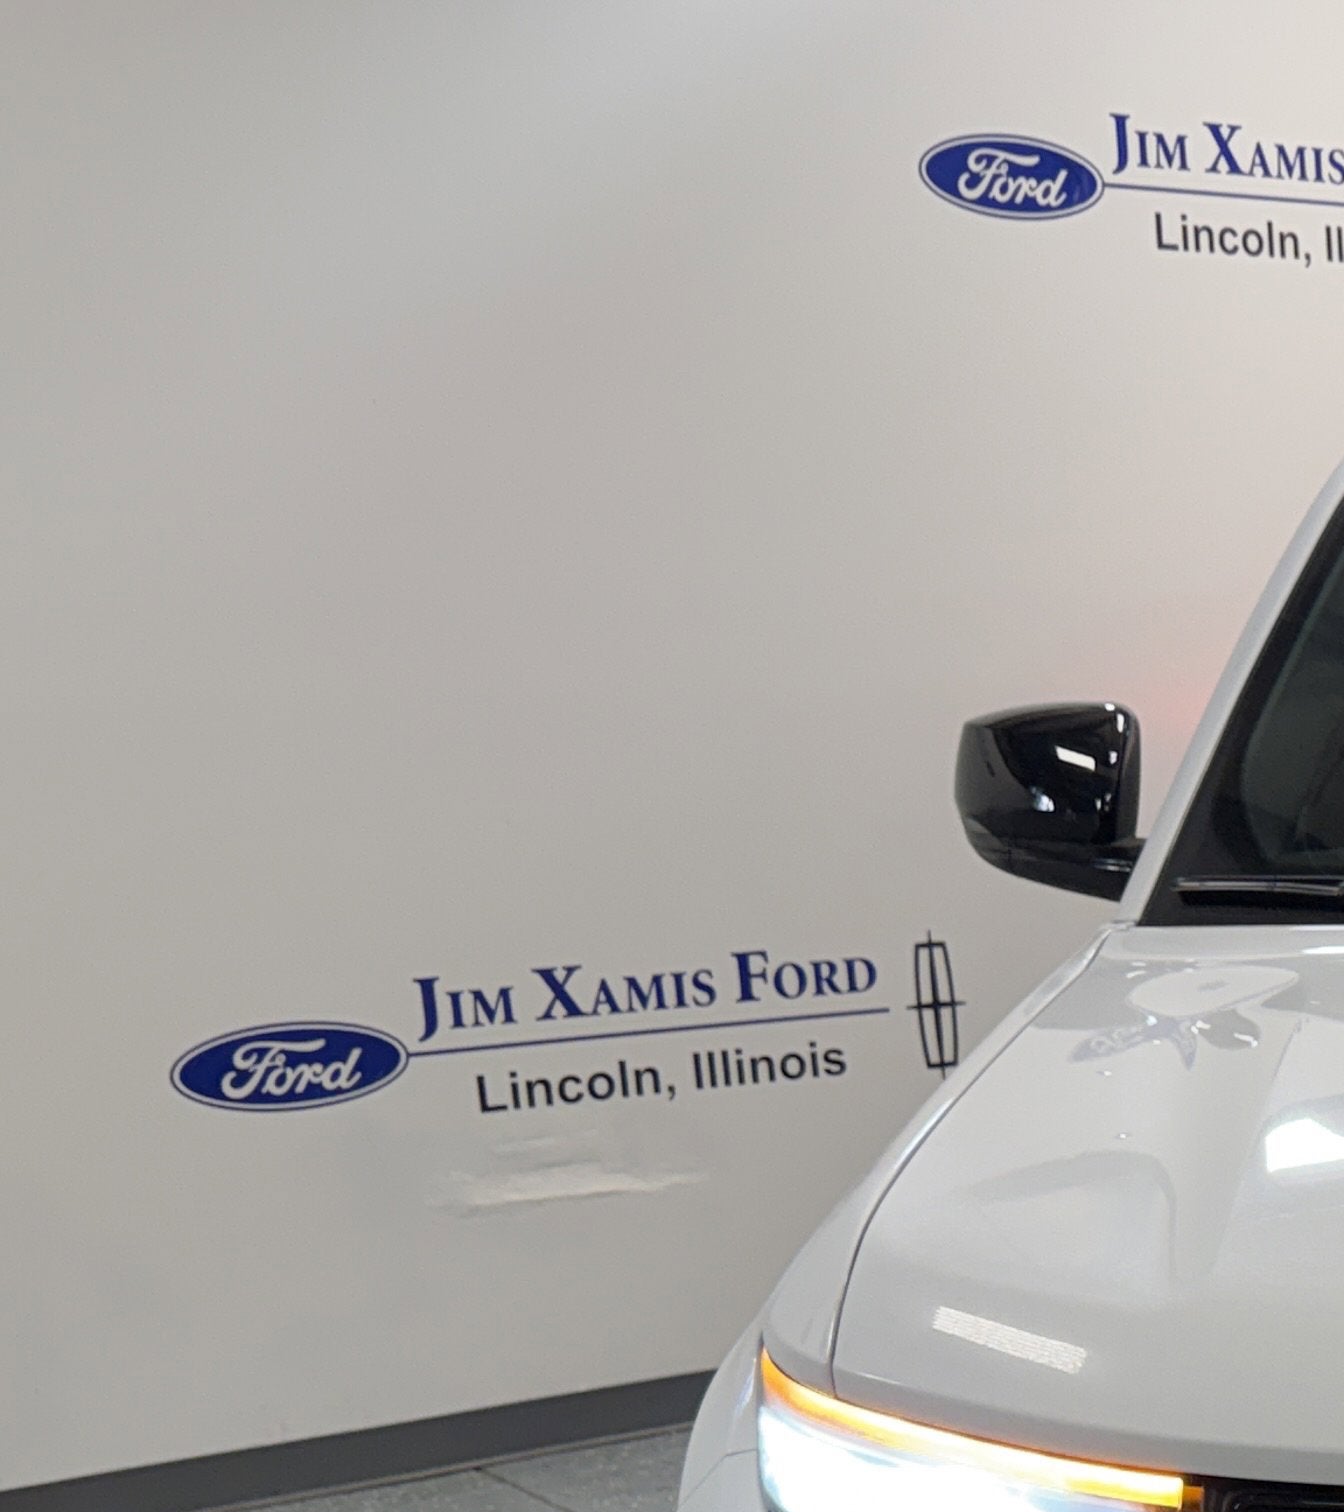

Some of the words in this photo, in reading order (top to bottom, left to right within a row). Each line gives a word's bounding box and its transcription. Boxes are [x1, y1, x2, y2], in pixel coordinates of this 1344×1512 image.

[957, 147, 1068, 207] Ford
[1153, 211, 1312, 268] Lincoln,
[220, 1038, 363, 1101] Ford
[476, 1057, 677, 1114] Lincoln,
[692, 1040, 847, 1095] Illinois
